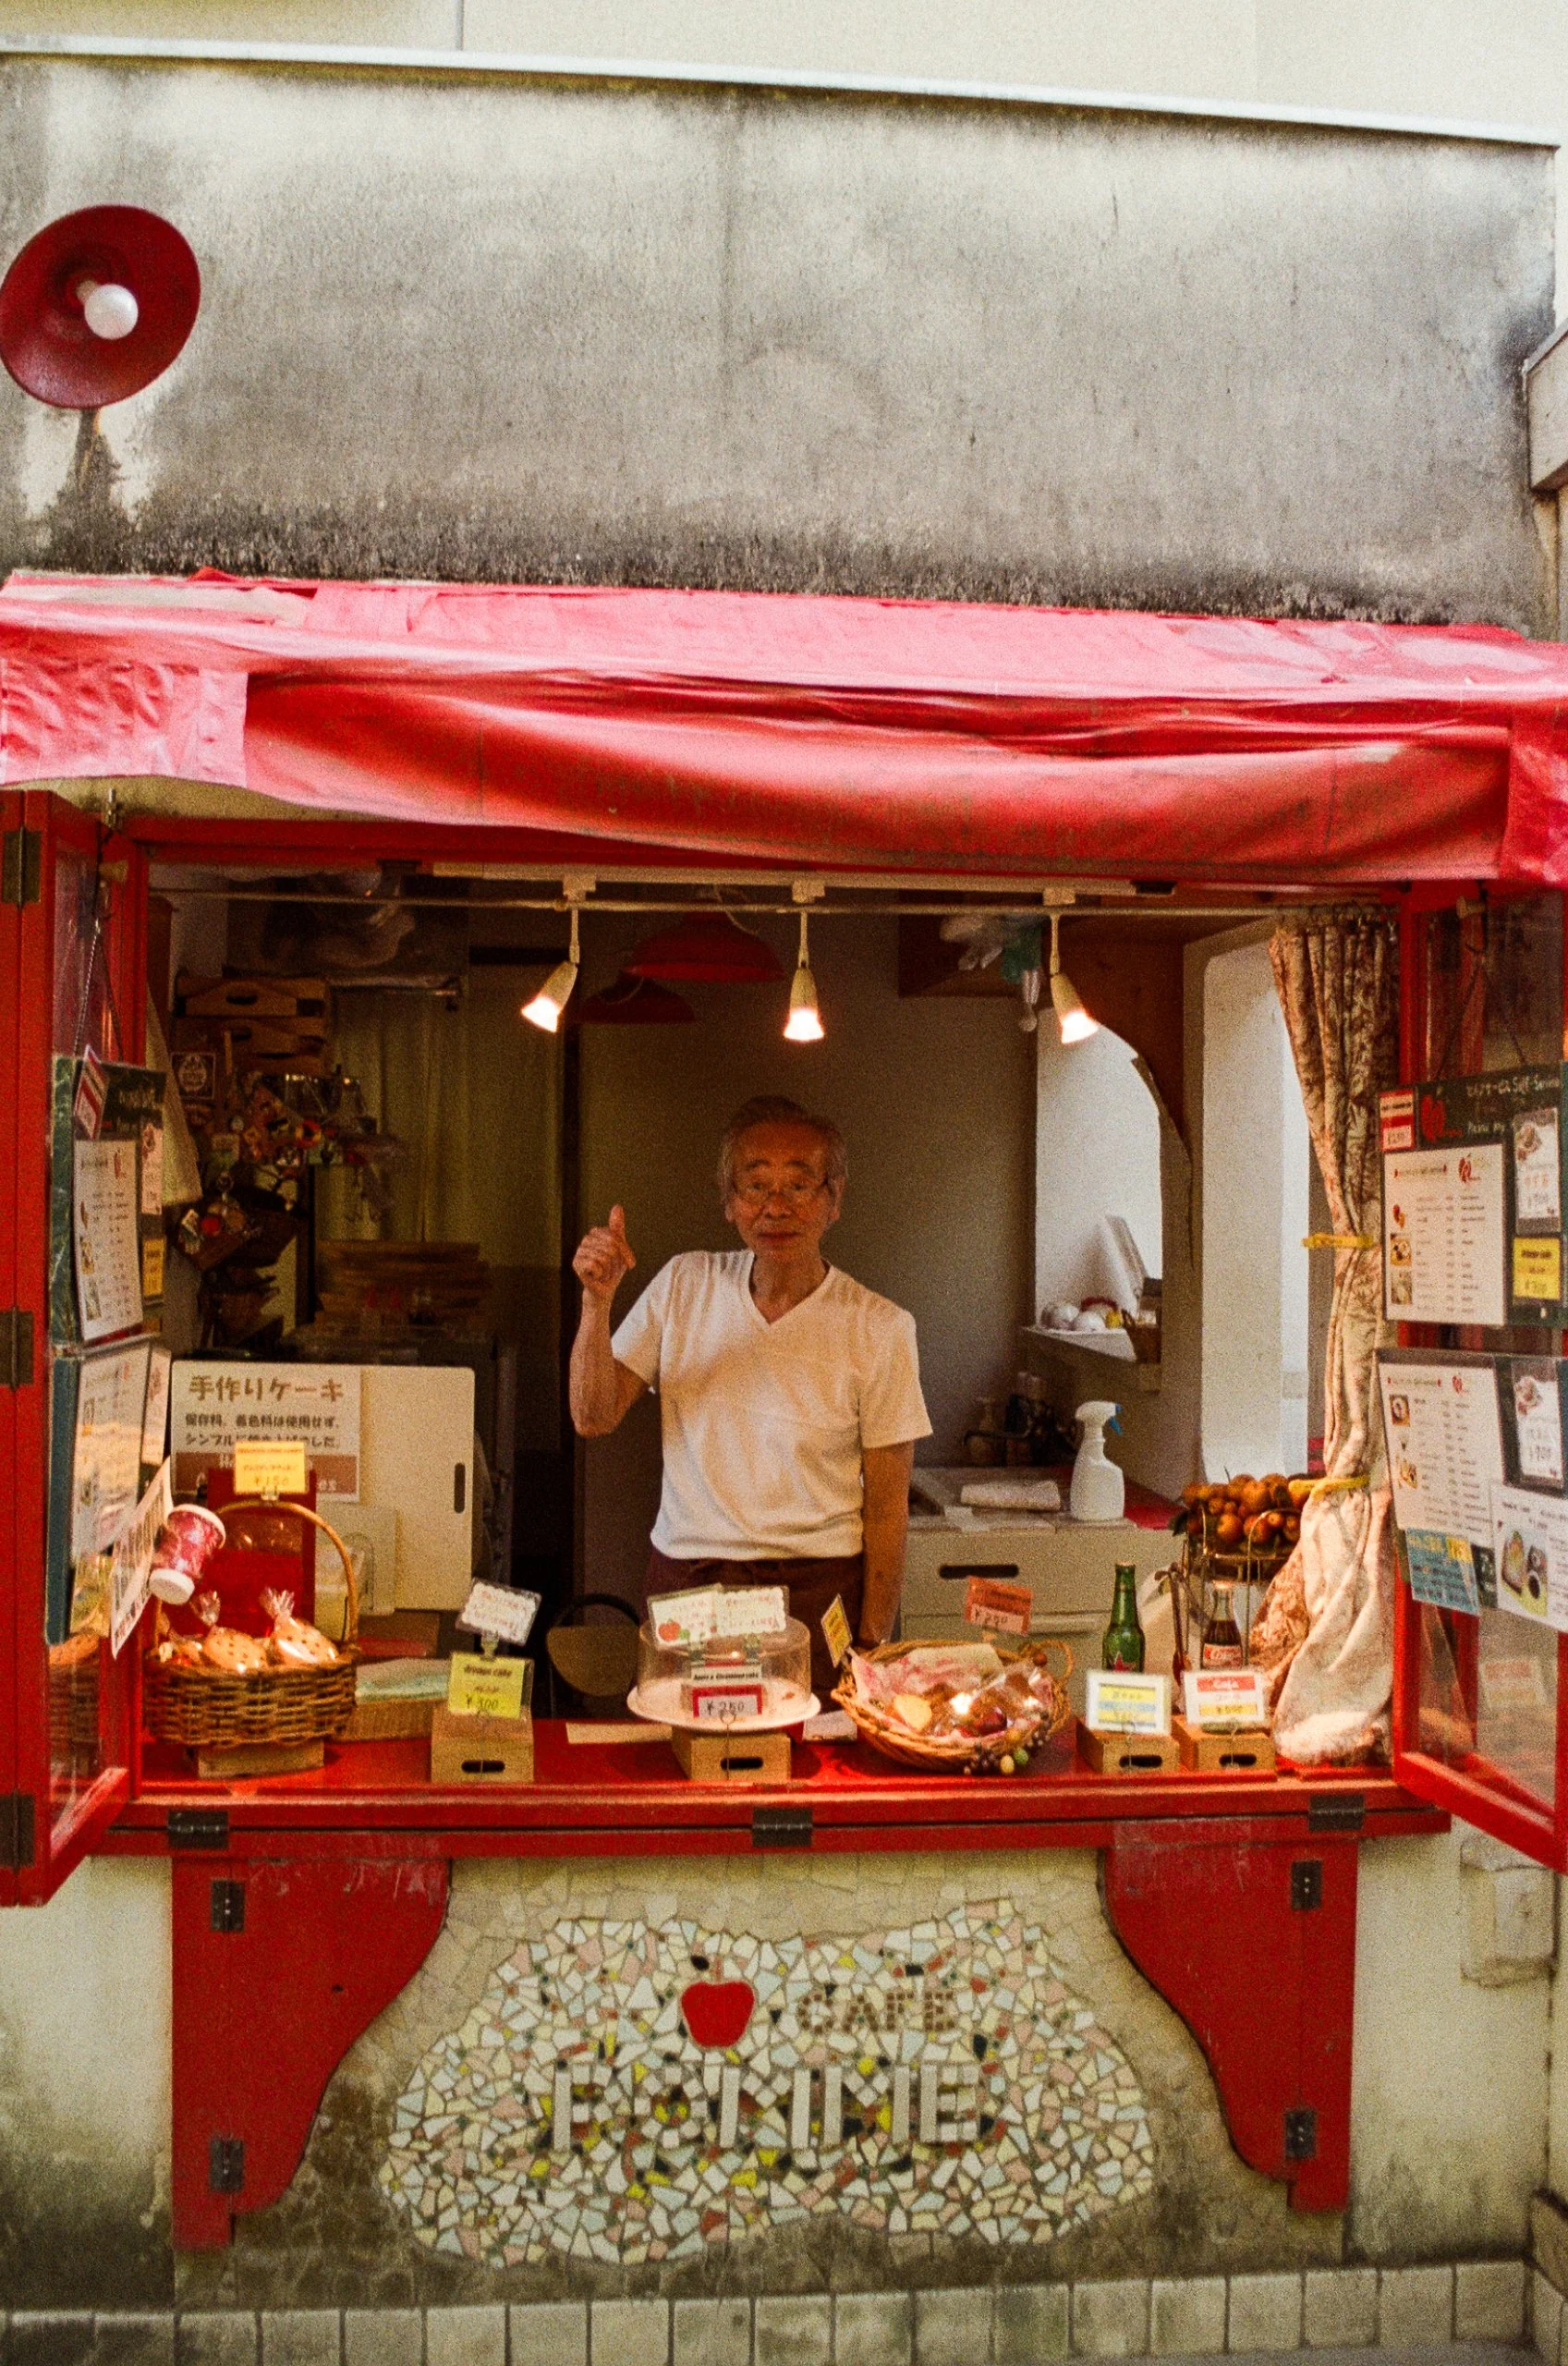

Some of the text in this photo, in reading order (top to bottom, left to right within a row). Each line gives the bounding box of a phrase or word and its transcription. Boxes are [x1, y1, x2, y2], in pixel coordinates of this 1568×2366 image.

[188, 1374, 344, 1403] 手作りケーキ
[797, 1991, 955, 2034] CAFE
